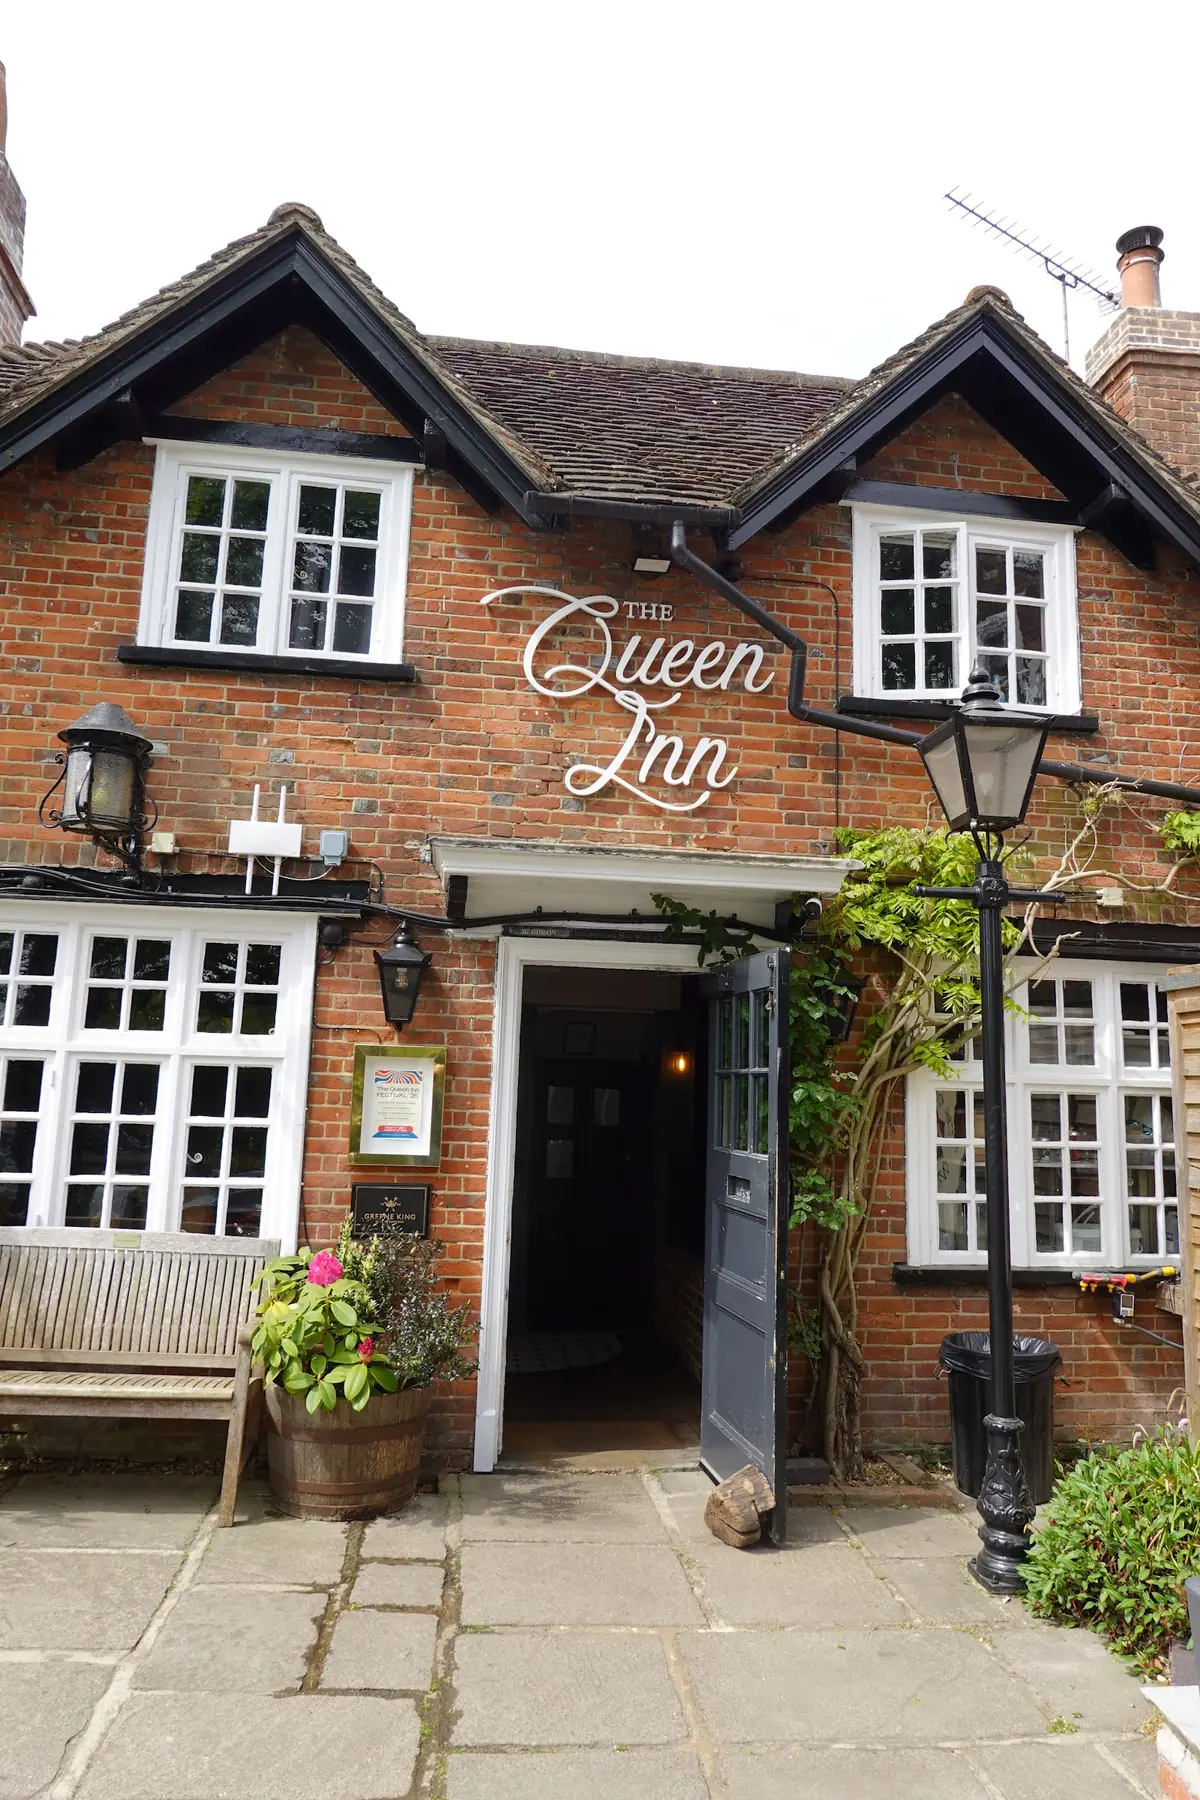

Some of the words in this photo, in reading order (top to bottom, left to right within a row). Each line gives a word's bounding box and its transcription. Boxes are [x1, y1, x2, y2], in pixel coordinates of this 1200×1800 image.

[480, 585, 775, 708] Queen
[622, 601, 674, 622] THE
[564, 691, 738, 811] Inn
